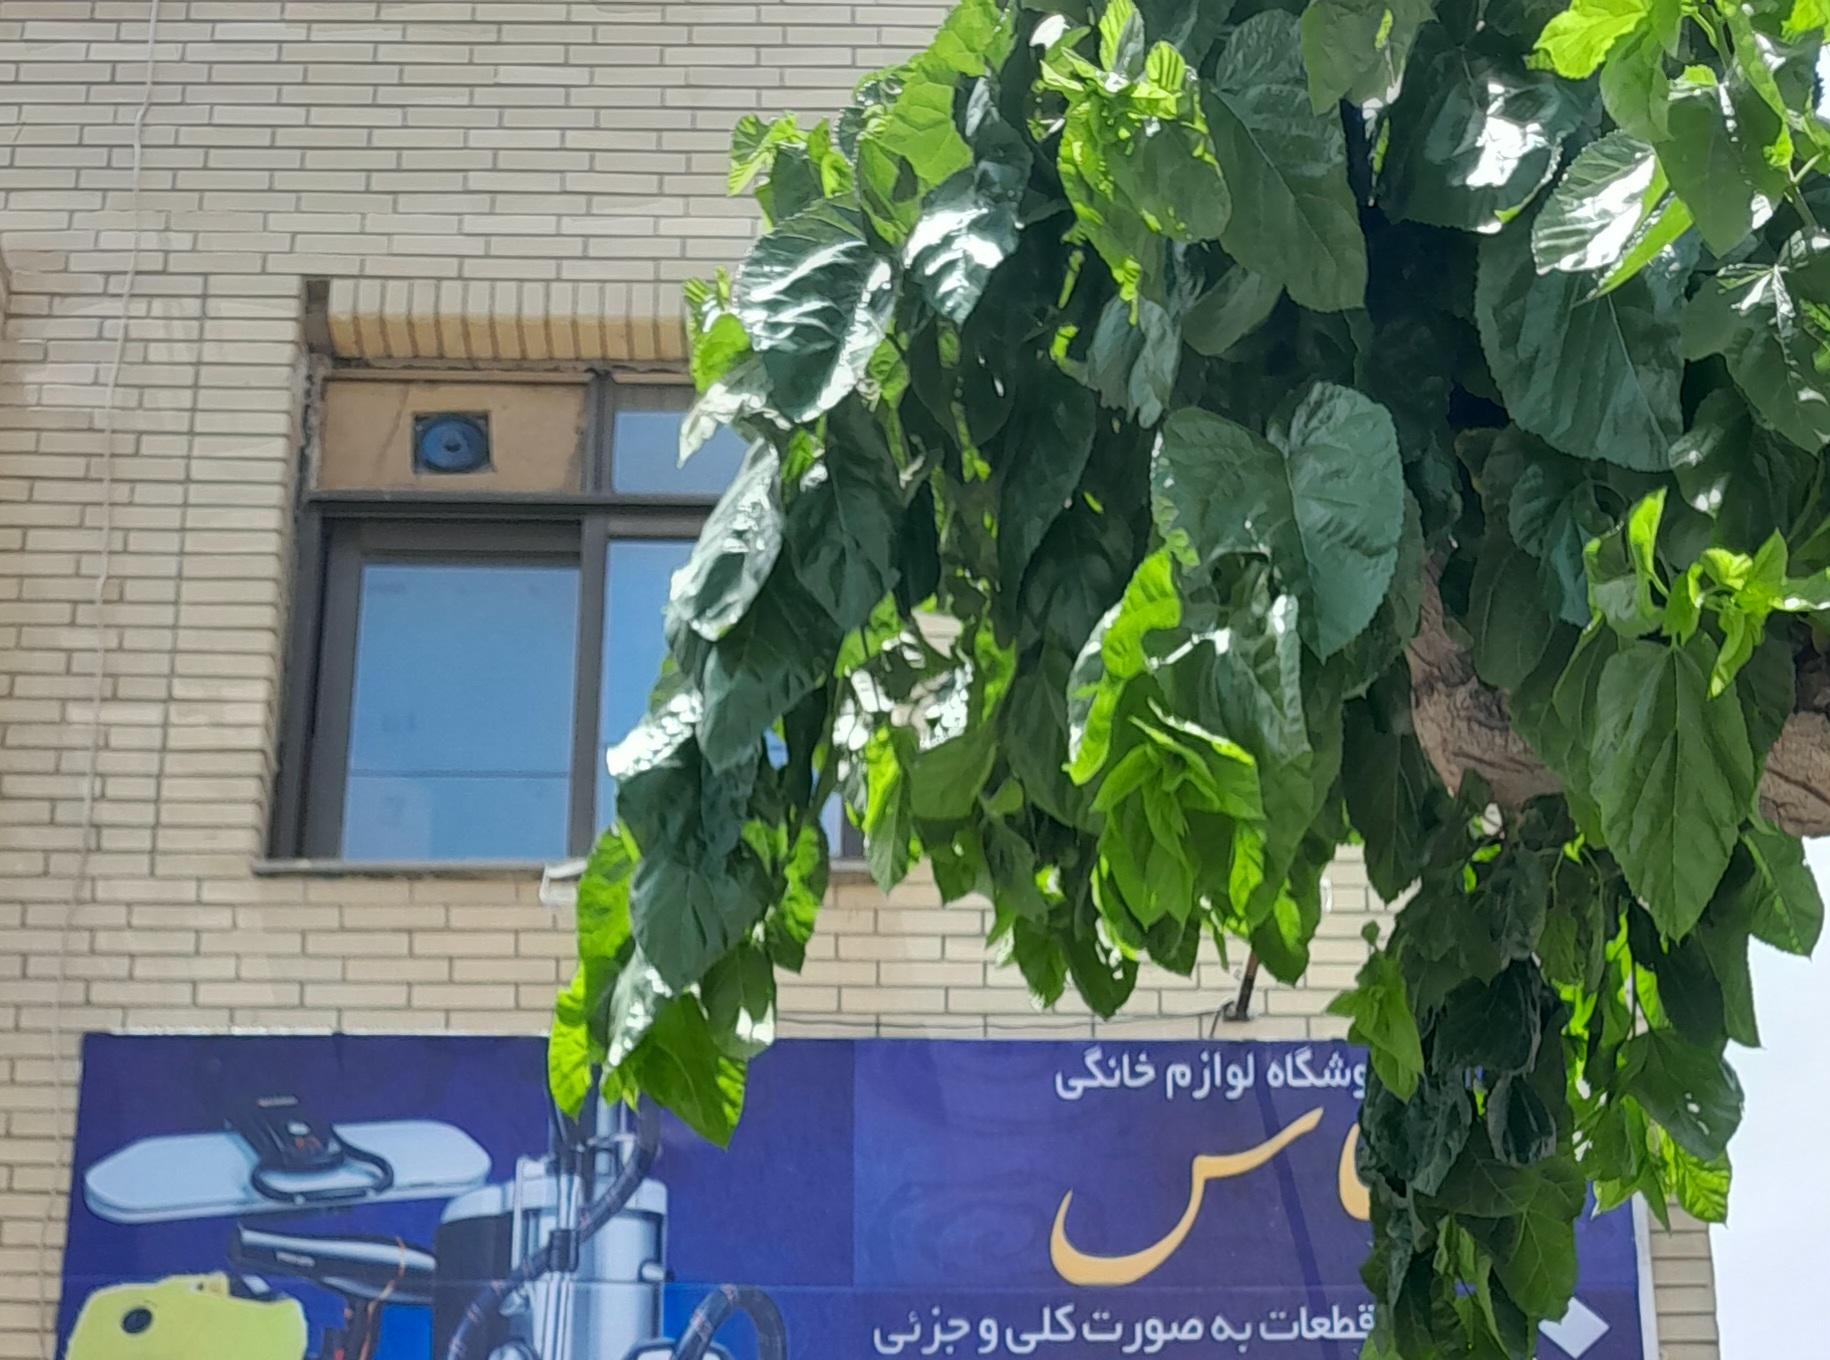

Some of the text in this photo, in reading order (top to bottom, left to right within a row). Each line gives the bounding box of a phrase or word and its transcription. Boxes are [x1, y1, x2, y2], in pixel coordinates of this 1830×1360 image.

[1055, 1044, 1367, 1099] وشگاه لوازم خانگی
[873, 1307, 972, 1356] جزئی
[977, 1316, 999, 1354] و
[1005, 1303, 1075, 1354] کلی
[1081, 1306, 1204, 1353] صورت
[1211, 1316, 1252, 1353] به
